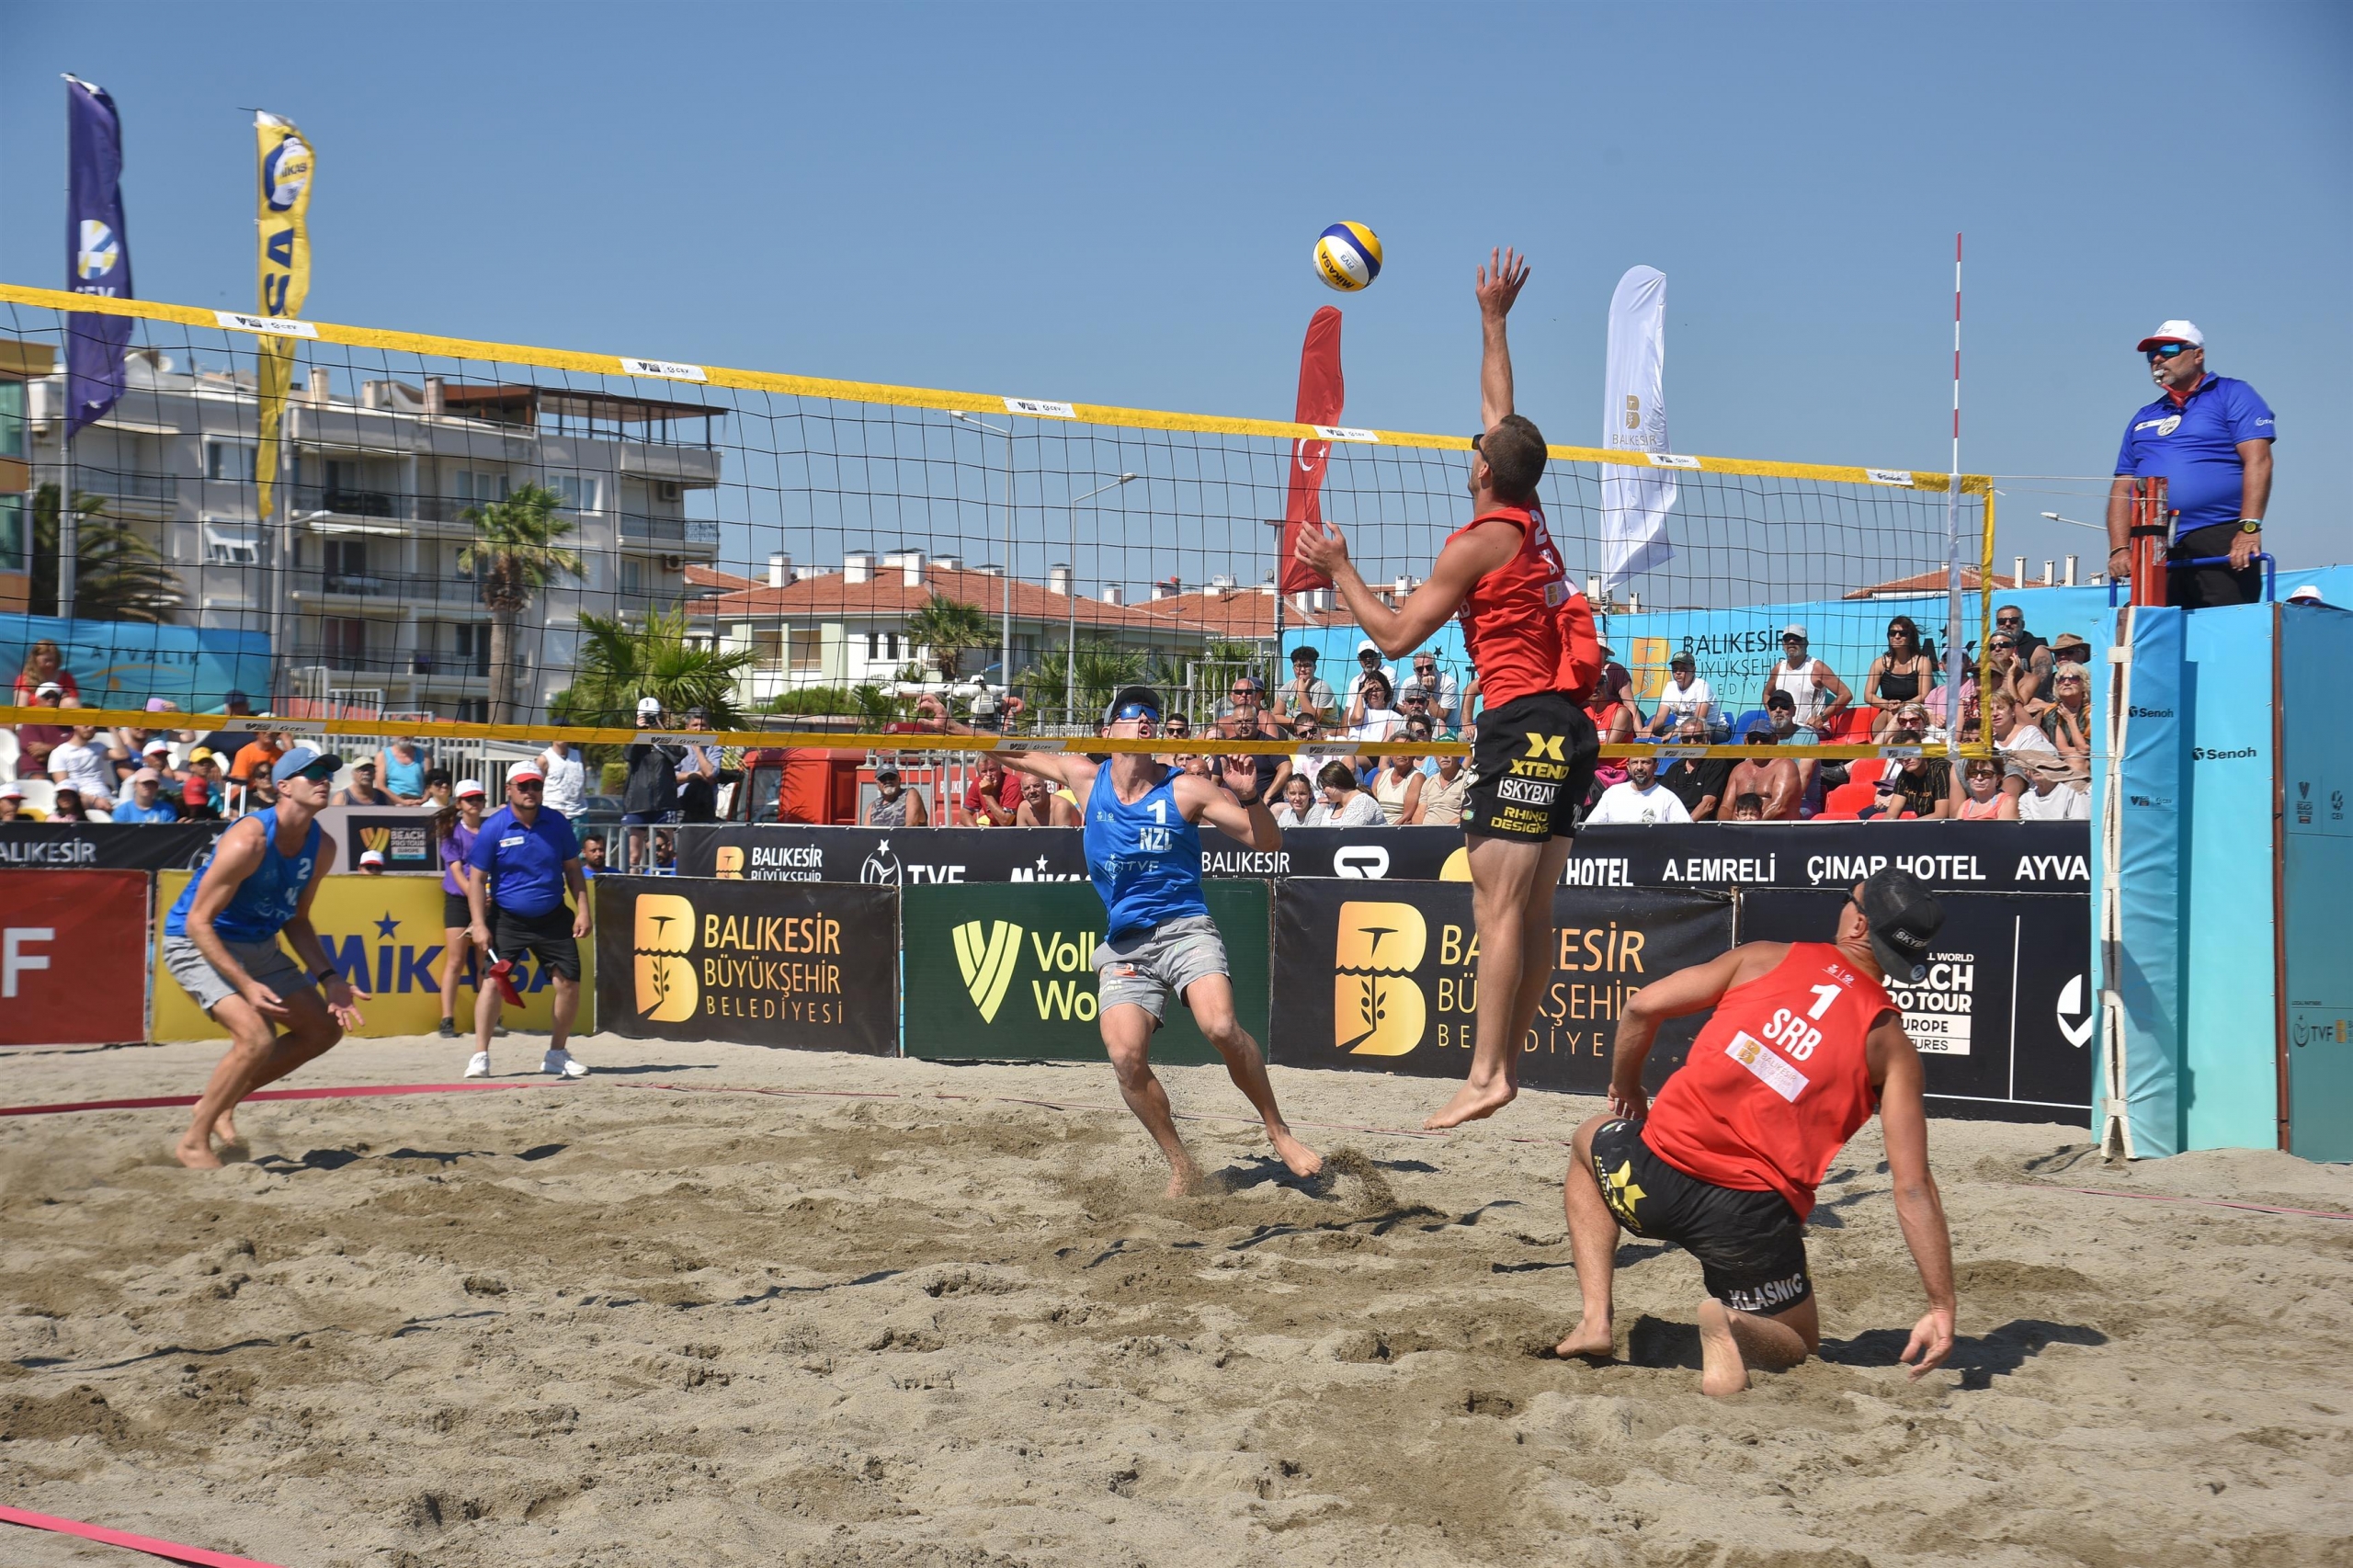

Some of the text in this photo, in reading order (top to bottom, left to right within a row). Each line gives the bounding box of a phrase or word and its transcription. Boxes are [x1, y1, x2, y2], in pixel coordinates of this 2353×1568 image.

[1321, 251, 1355, 289] MIKASA
[1529, 509, 1548, 546] 2
[2139, 708, 2174, 719] Senoh
[2206, 746, 2257, 761] Senoh
[1508, 758, 1570, 779] XTEND
[1147, 799, 1166, 824] 1
[1504, 806, 1549, 823] RHINO
[391, 831, 426, 840] BEACH
[751, 843, 824, 868] BALIKESİR
[1201, 851, 1290, 873] BALIKESİR
[1662, 852, 1776, 882] A.EMRELİ
[2014, 855, 2091, 881] AYVA
[297, 857, 312, 880] 2
[1566, 858, 1634, 886] HOTEL
[704, 912, 841, 955] BALIKESİR
[1439, 921, 1645, 973] BAESİR
[1937, 952, 1974, 962] WORLD
[2, 927, 55, 998] F
[704, 953, 842, 998] BÜYÜKŞEHİR
[706, 994, 843, 1025] BELEDİYESİ
[1807, 983, 1843, 1021] 1
[1916, 992, 1972, 1013] TOUR
[1762, 1007, 1823, 1062] SRB
[1902, 1017, 1949, 1033] UROPE
[2310, 1026, 2334, 1042] TVF
